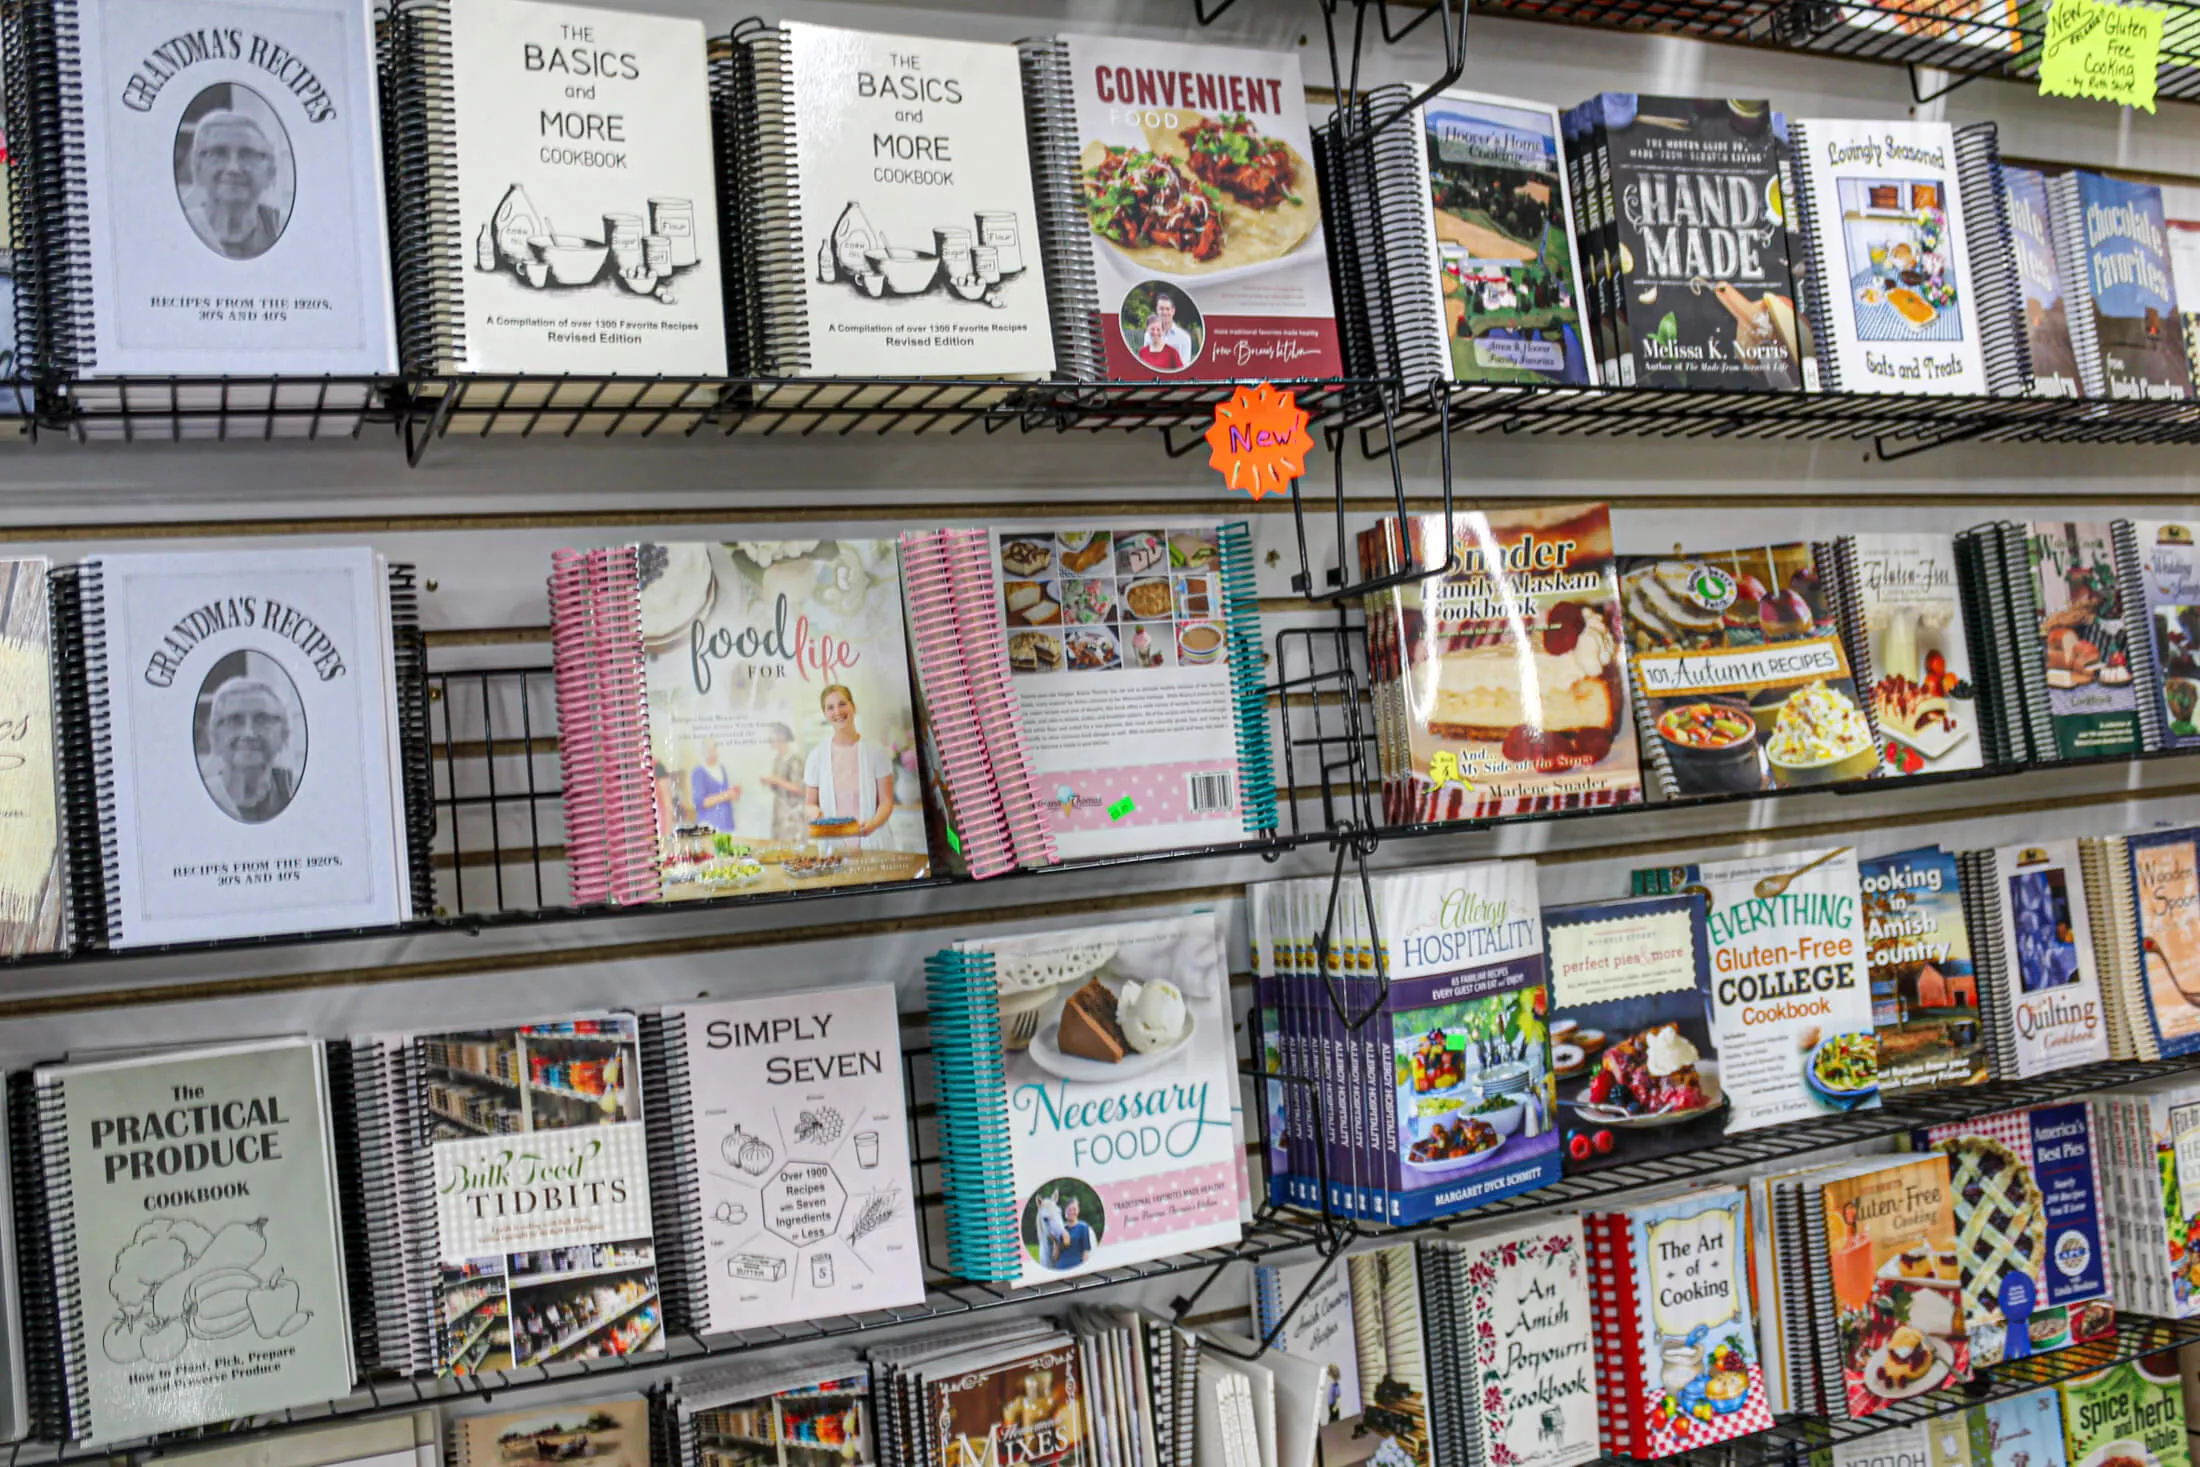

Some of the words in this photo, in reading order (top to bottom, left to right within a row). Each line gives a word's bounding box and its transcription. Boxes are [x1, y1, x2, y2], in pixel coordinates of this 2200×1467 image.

[560, 25, 594, 42] THE
[2105, 11, 2147, 39] Gluten
[524, 44, 640, 80] BASICS
[890, 53, 920, 70] THE
[2107, 39, 2134, 58] Free
[122, 28, 243, 112] GRANDMA'S
[248, 34, 337, 124] RECIPES
[2084, 52, 2135, 86] Cooking
[565, 85, 595, 100] and
[857, 72, 963, 105] BASICS
[1095, 65, 1282, 115] CONVENIENT
[540, 110, 626, 142] MORE
[895, 109, 923, 123] and
[1109, 107, 1179, 129] FOOD
[540, 146, 627, 169] COOKBOOK
[873, 133, 952, 161] MORE
[1828, 135, 1883, 168] Lovingly
[1885, 129, 1946, 171] Seasoned
[873, 167, 954, 186] COOKBOOK
[1634, 172, 1761, 228] HAND
[2086, 200, 2164, 258] Chocolate
[1642, 226, 1767, 280] MADE
[2092, 247, 2169, 303] Favorites
[150, 296, 210, 309] RECIPES
[217, 297, 254, 309] FROM
[260, 298, 289, 310] THE
[228, 312, 257, 322] AND
[486, 316, 494, 326] A
[496, 317, 556, 329] Compilation
[558, 318, 569, 328] of
[571, 320, 592, 329] over
[594, 320, 617, 330] 1300
[619, 320, 658, 331] Favorite
[660, 321, 699, 332] Recipes
[548, 331, 596, 344] Revised
[599, 332, 642, 345] Edition
[886, 336, 931, 347] Revised
[935, 336, 975, 347] Edition
[1643, 338, 1704, 360] Melissa
[1707, 337, 1728, 360] K.
[1733, 338, 1789, 360] Norris
[1898, 357, 1921, 380] and
[1922, 352, 1964, 380] Treats
[1229, 413, 1300, 454] New!
[1421, 577, 1495, 602] Family
[1507, 571, 1600, 594] Alaskan
[144, 596, 257, 688] GRANDMA'S
[263, 598, 346, 682] RECIPES
[691, 592, 797, 695] food
[794, 615, 860, 686] life
[747, 664, 787, 680] FOR
[1646, 668, 1670, 685] 101
[1670, 656, 1768, 688] Autumn
[1769, 651, 1835, 673] RECIPES
[1460, 763, 1479, 776] My
[1483, 760, 1512, 773] Side
[1516, 759, 1529, 771] of
[1488, 782, 1548, 798] Marlene
[1552, 776, 1608, 792] Snader
[1859, 864, 1942, 894] ooking
[1438, 886, 1511, 932] Allergy
[1889, 893, 1907, 912] in
[1705, 893, 1854, 946] EVERYTHING
[1867, 910, 1938, 941] Amish
[1403, 917, 1537, 969] HOSPITALITY
[1716, 937, 1853, 974] Gluten-Free
[1460, 970, 1486, 984] FAMILIAR
[1487, 966, 1509, 979] RECIPES
[1562, 955, 1611, 977] perfect
[1613, 953, 1641, 970] pies
[1651, 946, 1685, 963] more
[1432, 987, 1454, 1000] EVERY
[1454, 983, 1474, 996] GUEST
[1474, 980, 1488, 993] CAN
[1487, 978, 1498, 990] EAT
[1718, 962, 1855, 1006] COLLEGE
[1742, 996, 1832, 1027] Cookbook
[2017, 993, 2097, 1040] Quilting
[706, 1013, 833, 1050] SIMPLY
[766, 1051, 882, 1086] SEVEN
[1382, 1042, 1394, 1089] ALLERGY
[171, 1083, 204, 1101] The
[91, 1096, 290, 1149] PRACTICAL
[1014, 1078, 1232, 1158] Necessary
[1385, 1089, 1397, 1153] HOSPITALITY
[2034, 1118, 2086, 1142] America's
[104, 1131, 283, 1184] PRODUCE
[1073, 1126, 1161, 1168] FOOD
[2037, 1145, 2061, 1164] Best
[2062, 1141, 2086, 1159] Pies
[439, 1149, 514, 1195] Bulk
[518, 1139, 602, 1187] Food
[780, 1170, 803, 1183] Over
[805, 1167, 829, 1179] 1900
[143, 1181, 250, 1212] COOKBOOK
[466, 1177, 628, 1220] TIDBITS
[785, 1182, 826, 1197] Recipes
[1113, 1198, 1152, 1210] TRADITIONAL
[1152, 1191, 1182, 1203] FAVORITES
[1183, 1187, 1200, 1198] MADE
[1200, 1182, 1225, 1194] HEALTHY
[1435, 1183, 1483, 1207] MARGARET
[1483, 1178, 1505, 1195] DYCK
[1505, 1166, 1542, 1190] SCHMITT
[2060, 1189, 2087, 1203] Recipes
[776, 1211, 832, 1229] Ingredients
[796, 1198, 827, 1211] Seven
[1843, 1184, 1942, 1238] Gluten-Free
[801, 1228, 825, 1240] Less
[1659, 1239, 1691, 1262] The
[1696, 1232, 1724, 1253] Art
[1685, 1260, 1700, 1277] of
[1517, 1278, 1556, 1306] An
[1659, 1278, 1730, 1308] Cooking
[1505, 1300, 1569, 1338] Amish
[128, 1369, 155, 1385] How
[159, 1367, 172, 1379] to
[215, 1355, 244, 1371] Pick,
[248, 1346, 296, 1366] Prepare
[231, 1362, 281, 1379] Produce
[2079, 1391, 2129, 1434] spice
[2113, 1419, 2133, 1440] and
[2133, 1388, 2176, 1433] herb
[957, 1424, 1069, 1467] MIXES
[2144, 1428, 2178, 1451] bible
